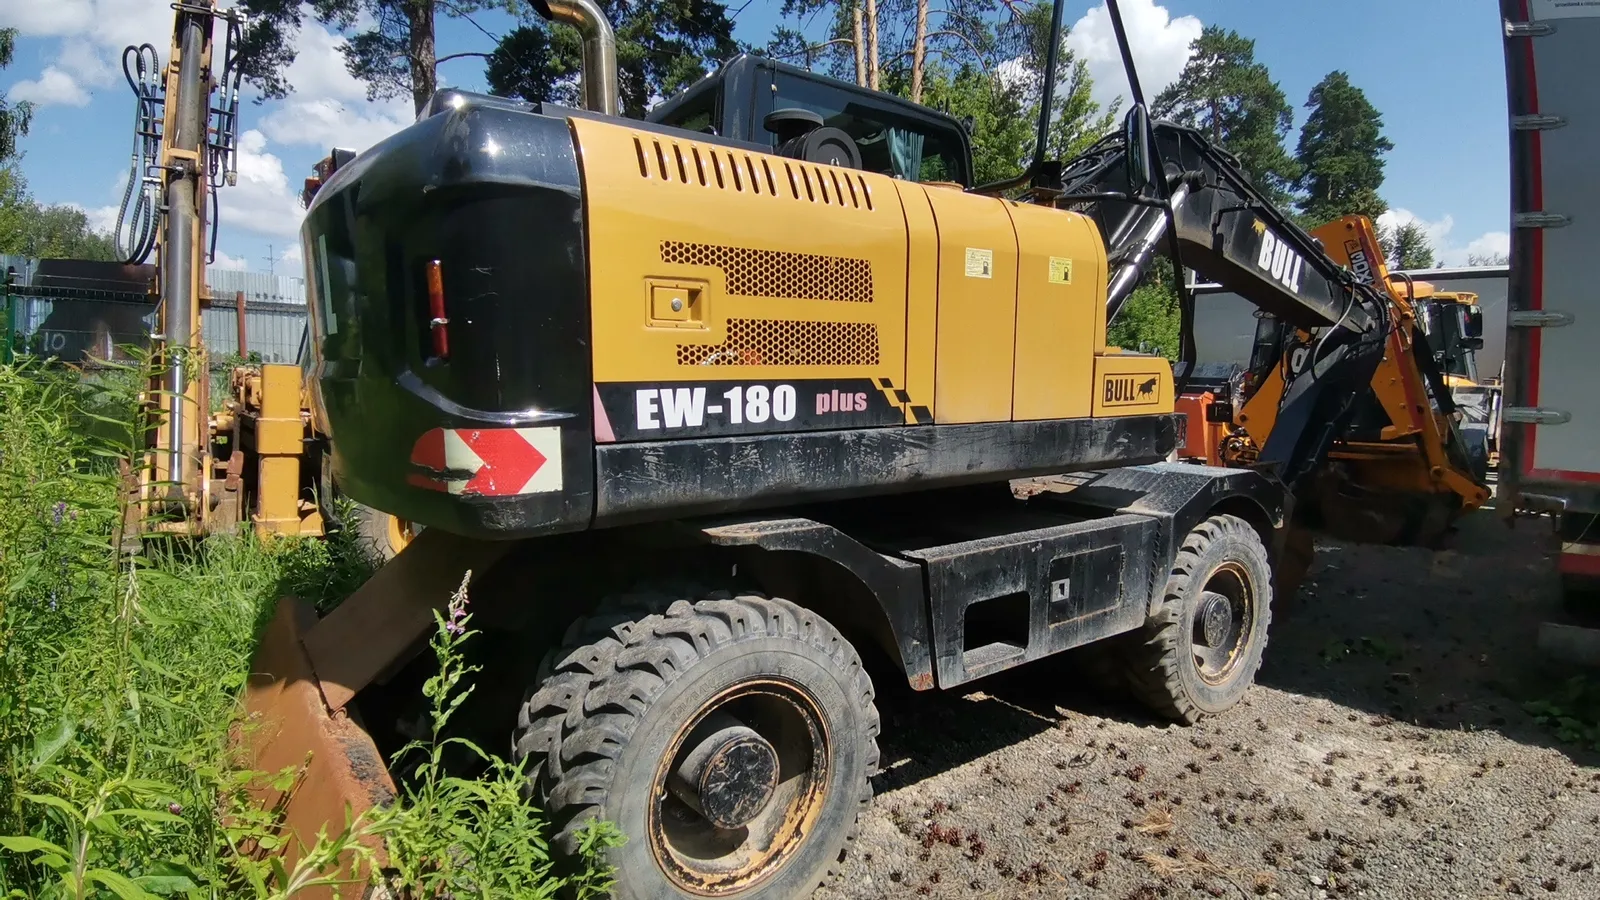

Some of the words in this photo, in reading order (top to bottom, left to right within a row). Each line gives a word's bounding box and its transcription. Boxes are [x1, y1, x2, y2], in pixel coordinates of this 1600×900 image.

[1258, 229, 1302, 294] BULL
[635, 384, 797, 430] EW-180
[815, 389, 868, 415] plus
[1104, 378, 1135, 402] BULL
